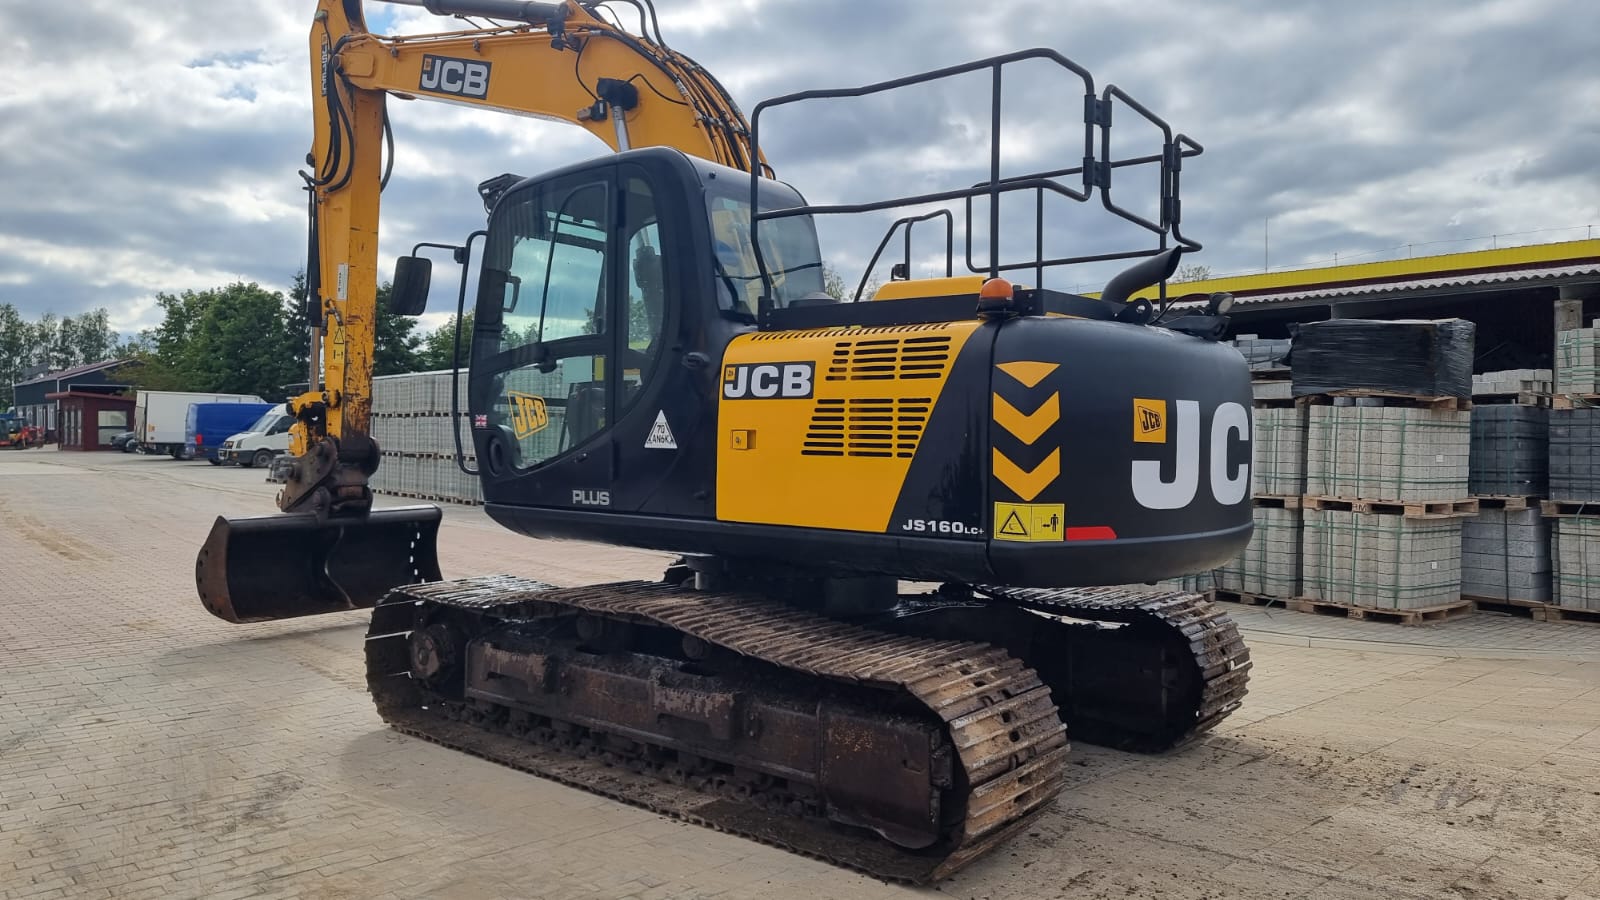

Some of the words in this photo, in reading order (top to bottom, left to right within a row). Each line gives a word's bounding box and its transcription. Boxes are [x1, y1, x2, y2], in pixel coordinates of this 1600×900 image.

[422, 59, 488, 96] JCB
[724, 364, 812, 398] JCB
[514, 395, 547, 433] JCB
[1142, 409, 1161, 431] JCB
[1131, 399, 1255, 510] JC
[572, 489, 610, 506] PLUS
